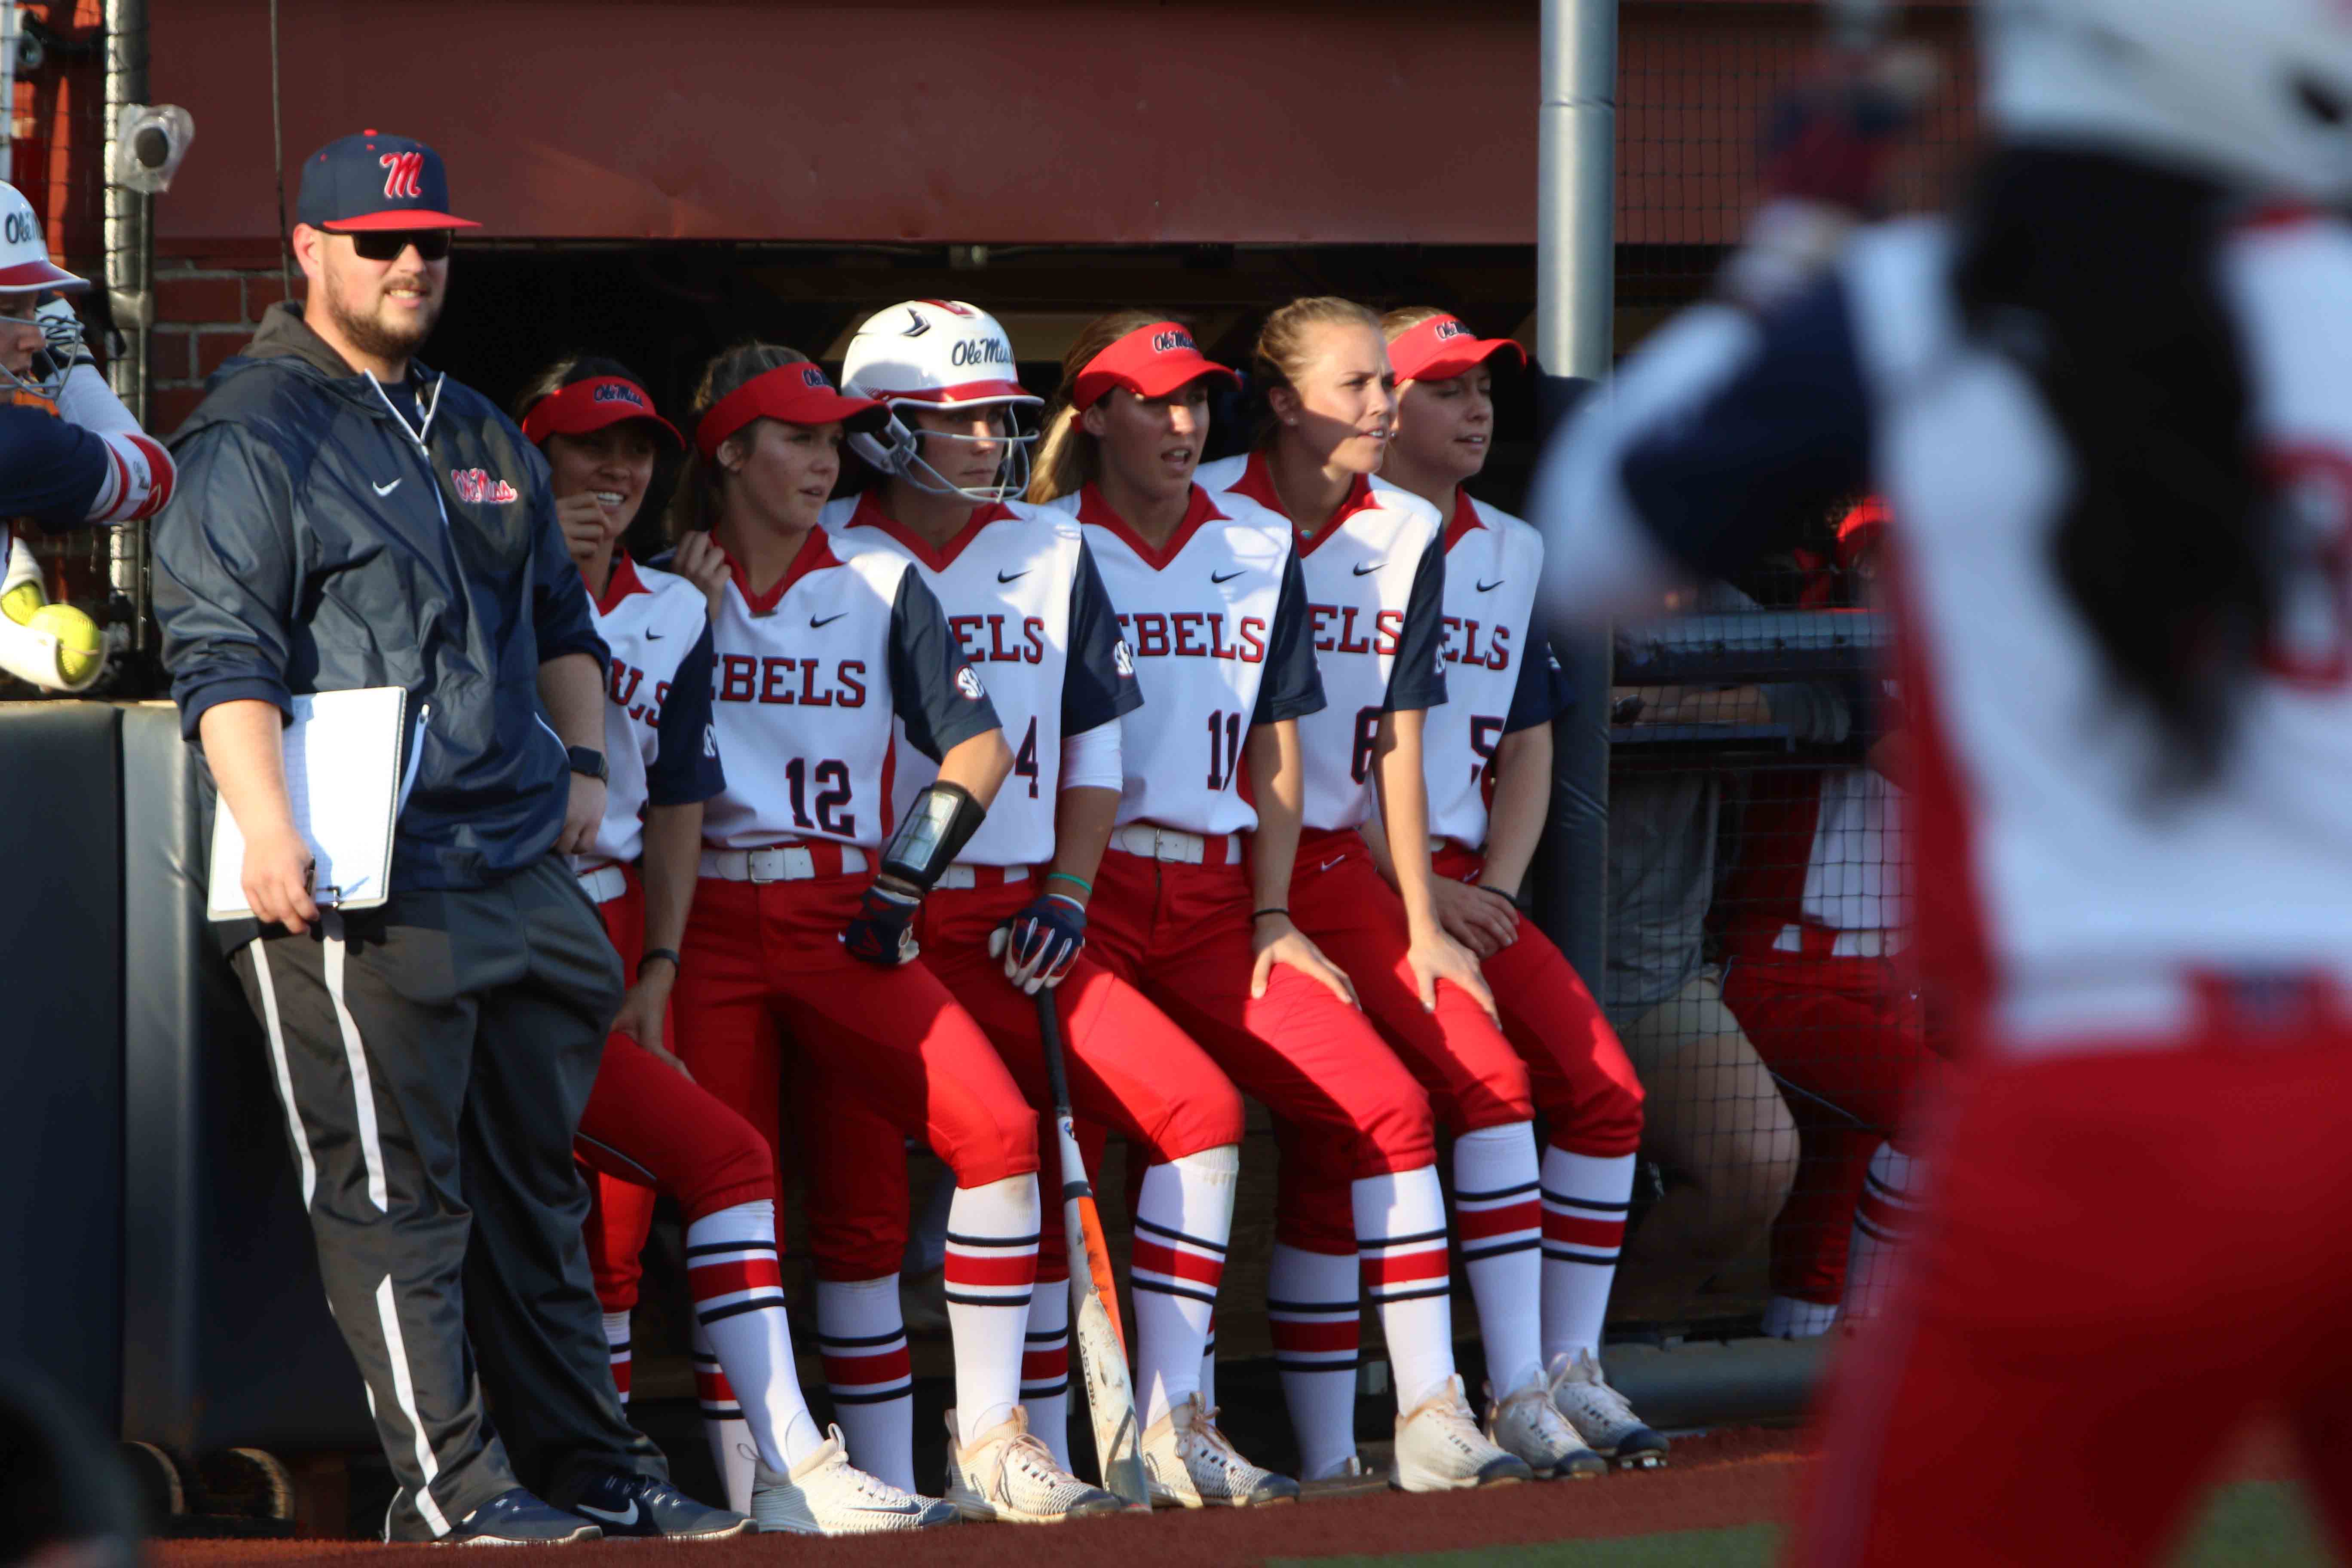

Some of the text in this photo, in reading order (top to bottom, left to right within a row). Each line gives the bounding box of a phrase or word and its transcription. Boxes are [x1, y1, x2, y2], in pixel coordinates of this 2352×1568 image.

[380, 151, 423, 198] M
[952, 338, 982, 366] Ole
[594, 384, 615, 402] Ole
[710, 653, 866, 708] BELS
[1015, 715, 1038, 799] 4
[1207, 709, 1241, 791] 11
[785, 757, 855, 837] 12
